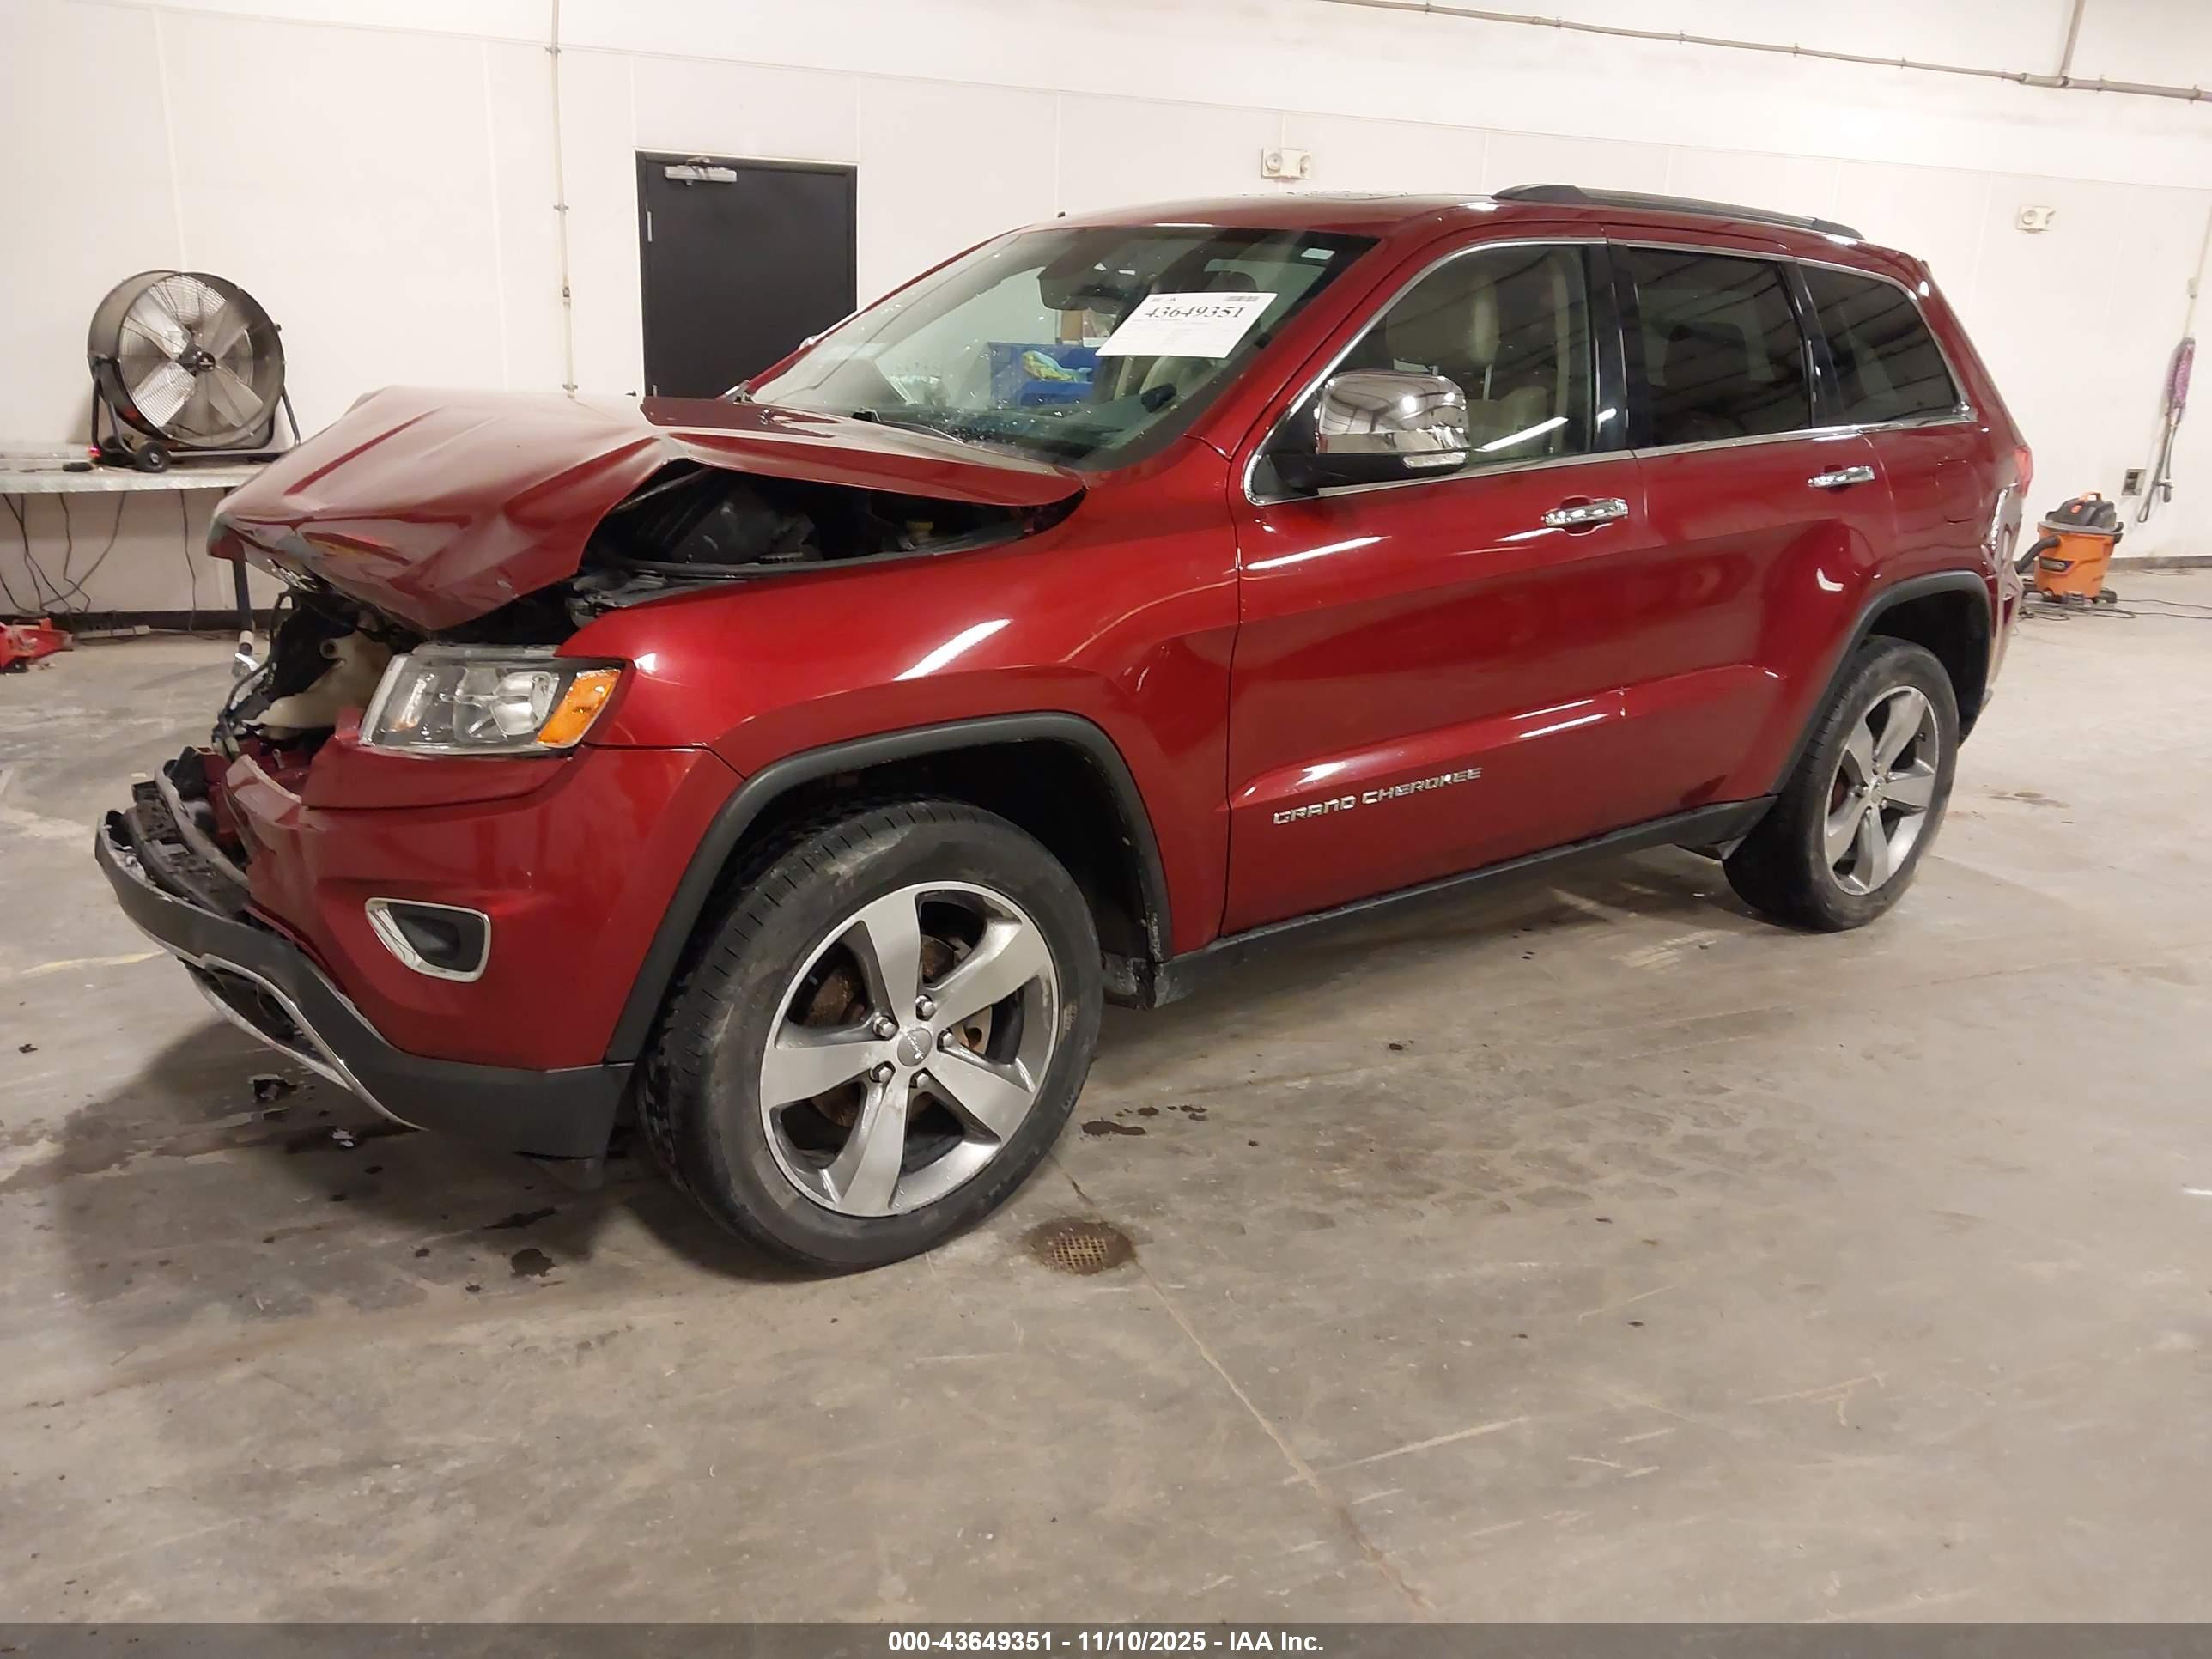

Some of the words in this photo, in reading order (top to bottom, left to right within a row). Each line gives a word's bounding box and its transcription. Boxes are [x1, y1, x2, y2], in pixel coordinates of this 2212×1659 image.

[1145, 306, 1244, 318] 43649351
[1273, 795, 1356, 824] GRAND
[1361, 767, 1483, 804] CHEROKEE
